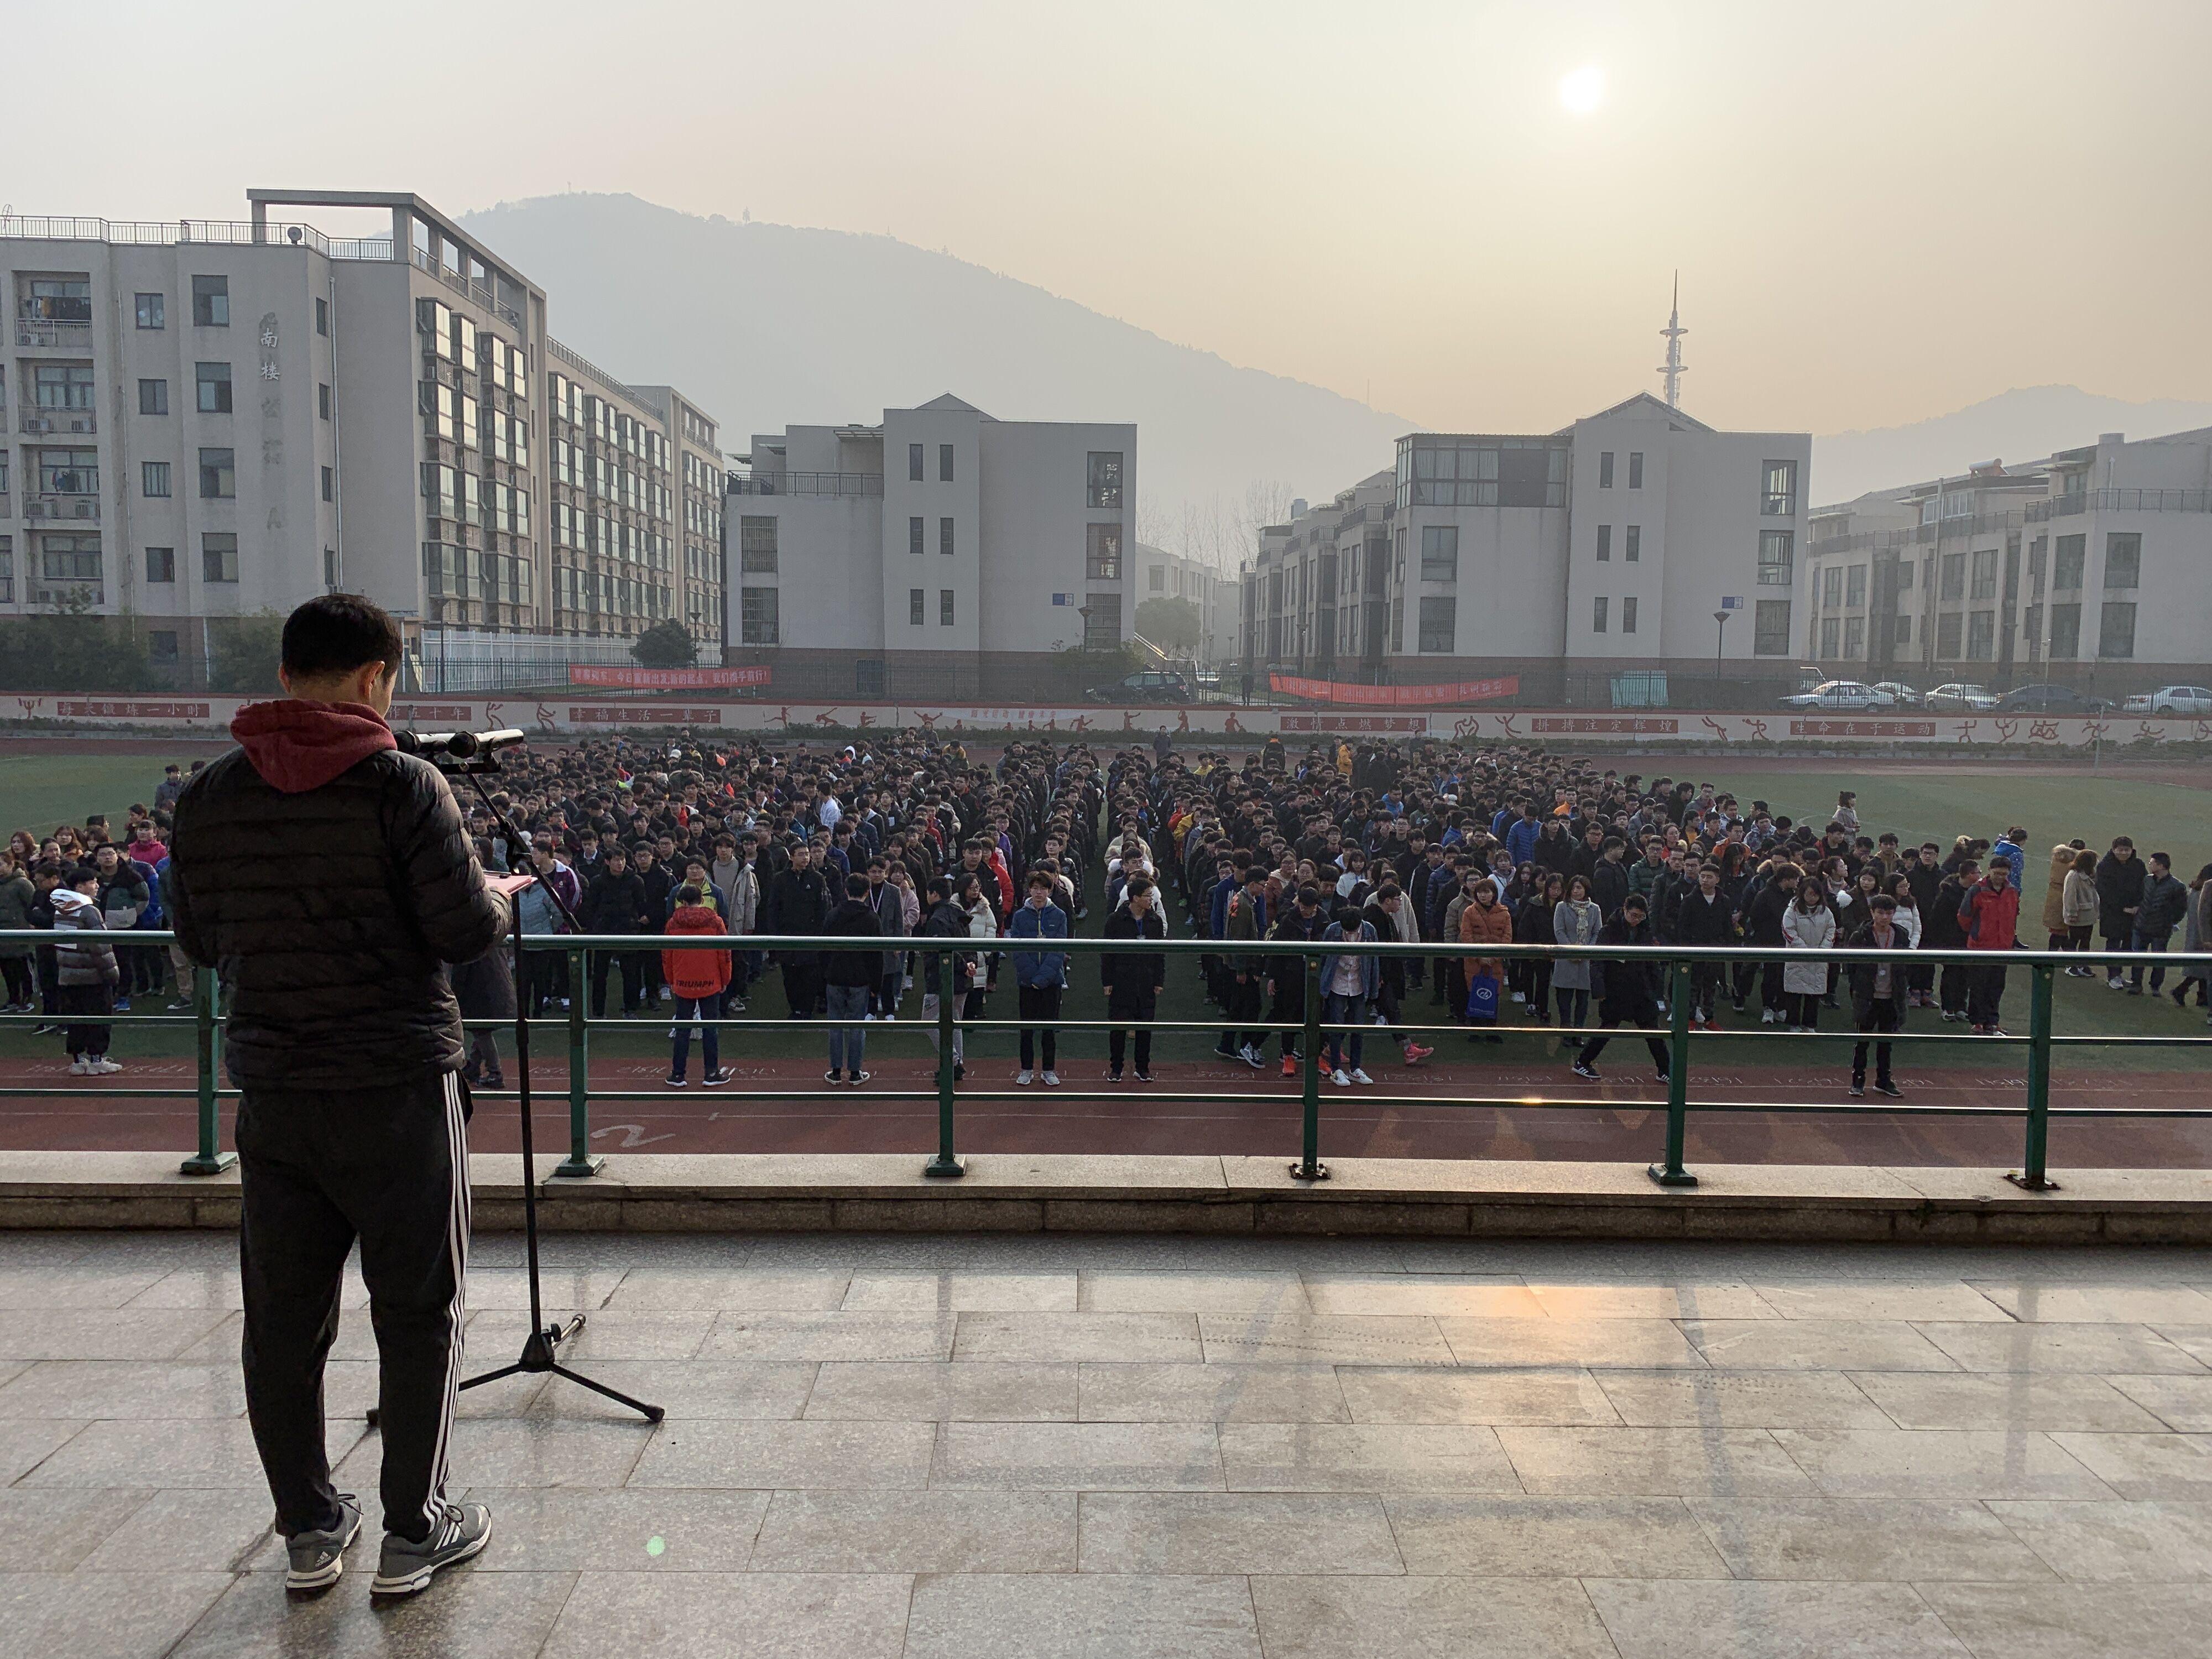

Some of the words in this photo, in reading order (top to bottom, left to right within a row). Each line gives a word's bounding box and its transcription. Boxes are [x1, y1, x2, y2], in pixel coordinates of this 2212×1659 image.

[260, 327, 279, 380] 南楼
[60, 702, 200, 717] 每天锻炼一小时
[573, 708, 718, 723] 幸福生活一辈子
[1286, 718, 1421, 731] 激情点燃梦想
[1536, 719, 1678, 734] 拼搏注定辉煌
[1796, 722, 1930, 736] 生命在于运动
